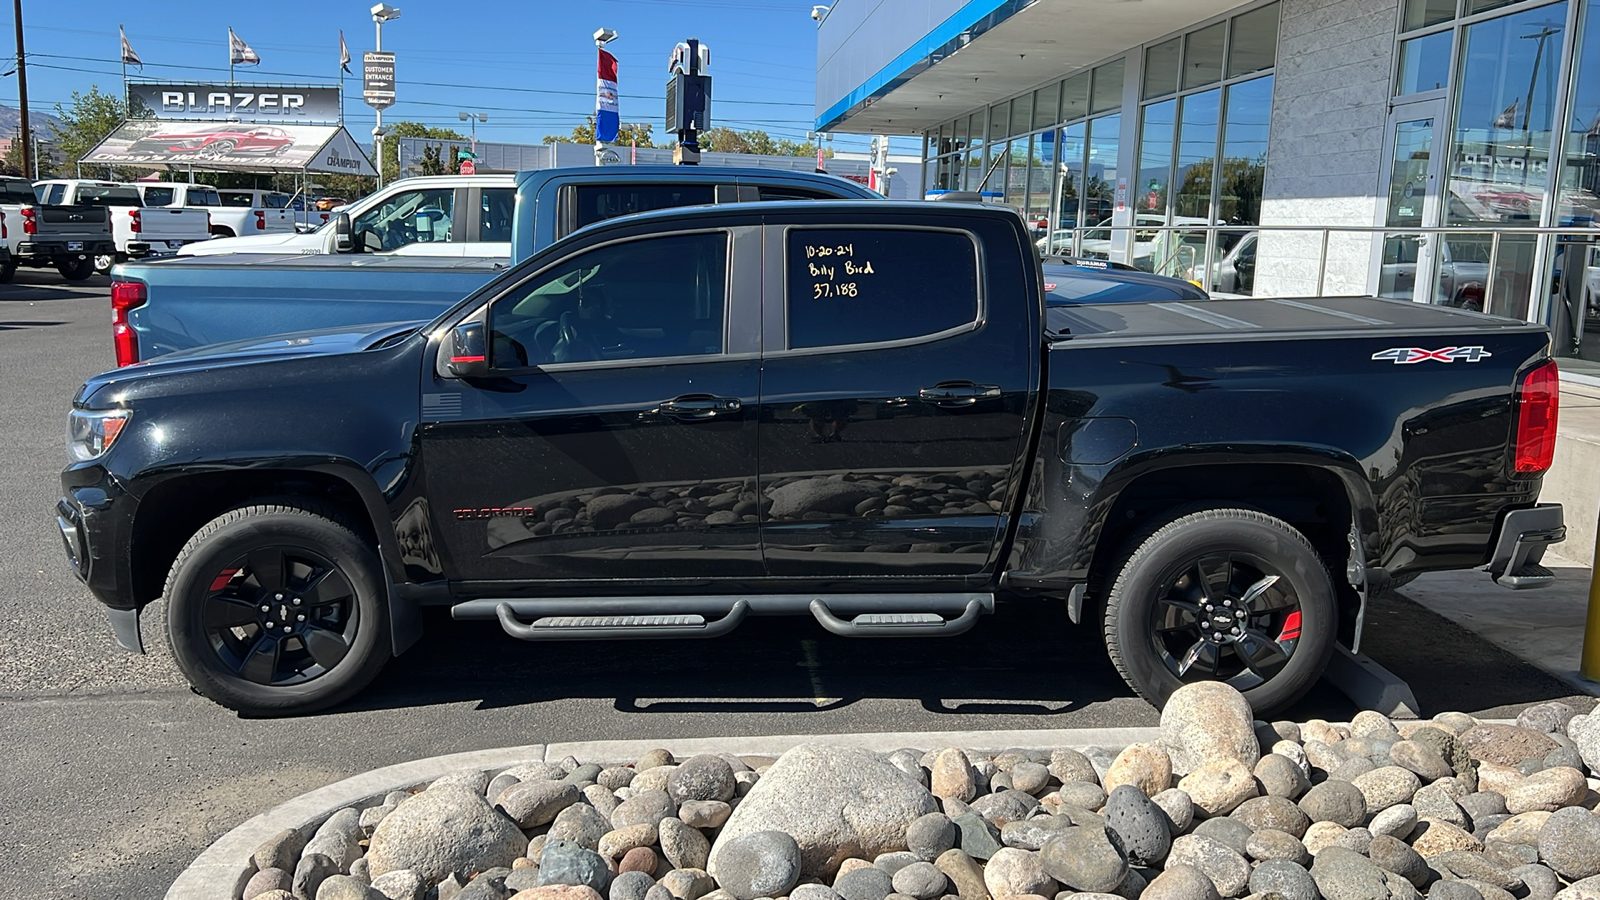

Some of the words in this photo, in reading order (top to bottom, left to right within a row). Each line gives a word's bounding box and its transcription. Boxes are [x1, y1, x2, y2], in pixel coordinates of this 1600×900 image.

[365, 73, 394, 81] ENTRANCE
[162, 91, 306, 116] BLAZER
[93, 153, 167, 162] Chevy's
[327, 156, 361, 170] CHAMPION
[461, 166, 474, 174] STOP
[844, 260, 875, 275] Bird
[813, 282, 858, 300] 37,188
[453, 507, 534, 519] COLORADO
